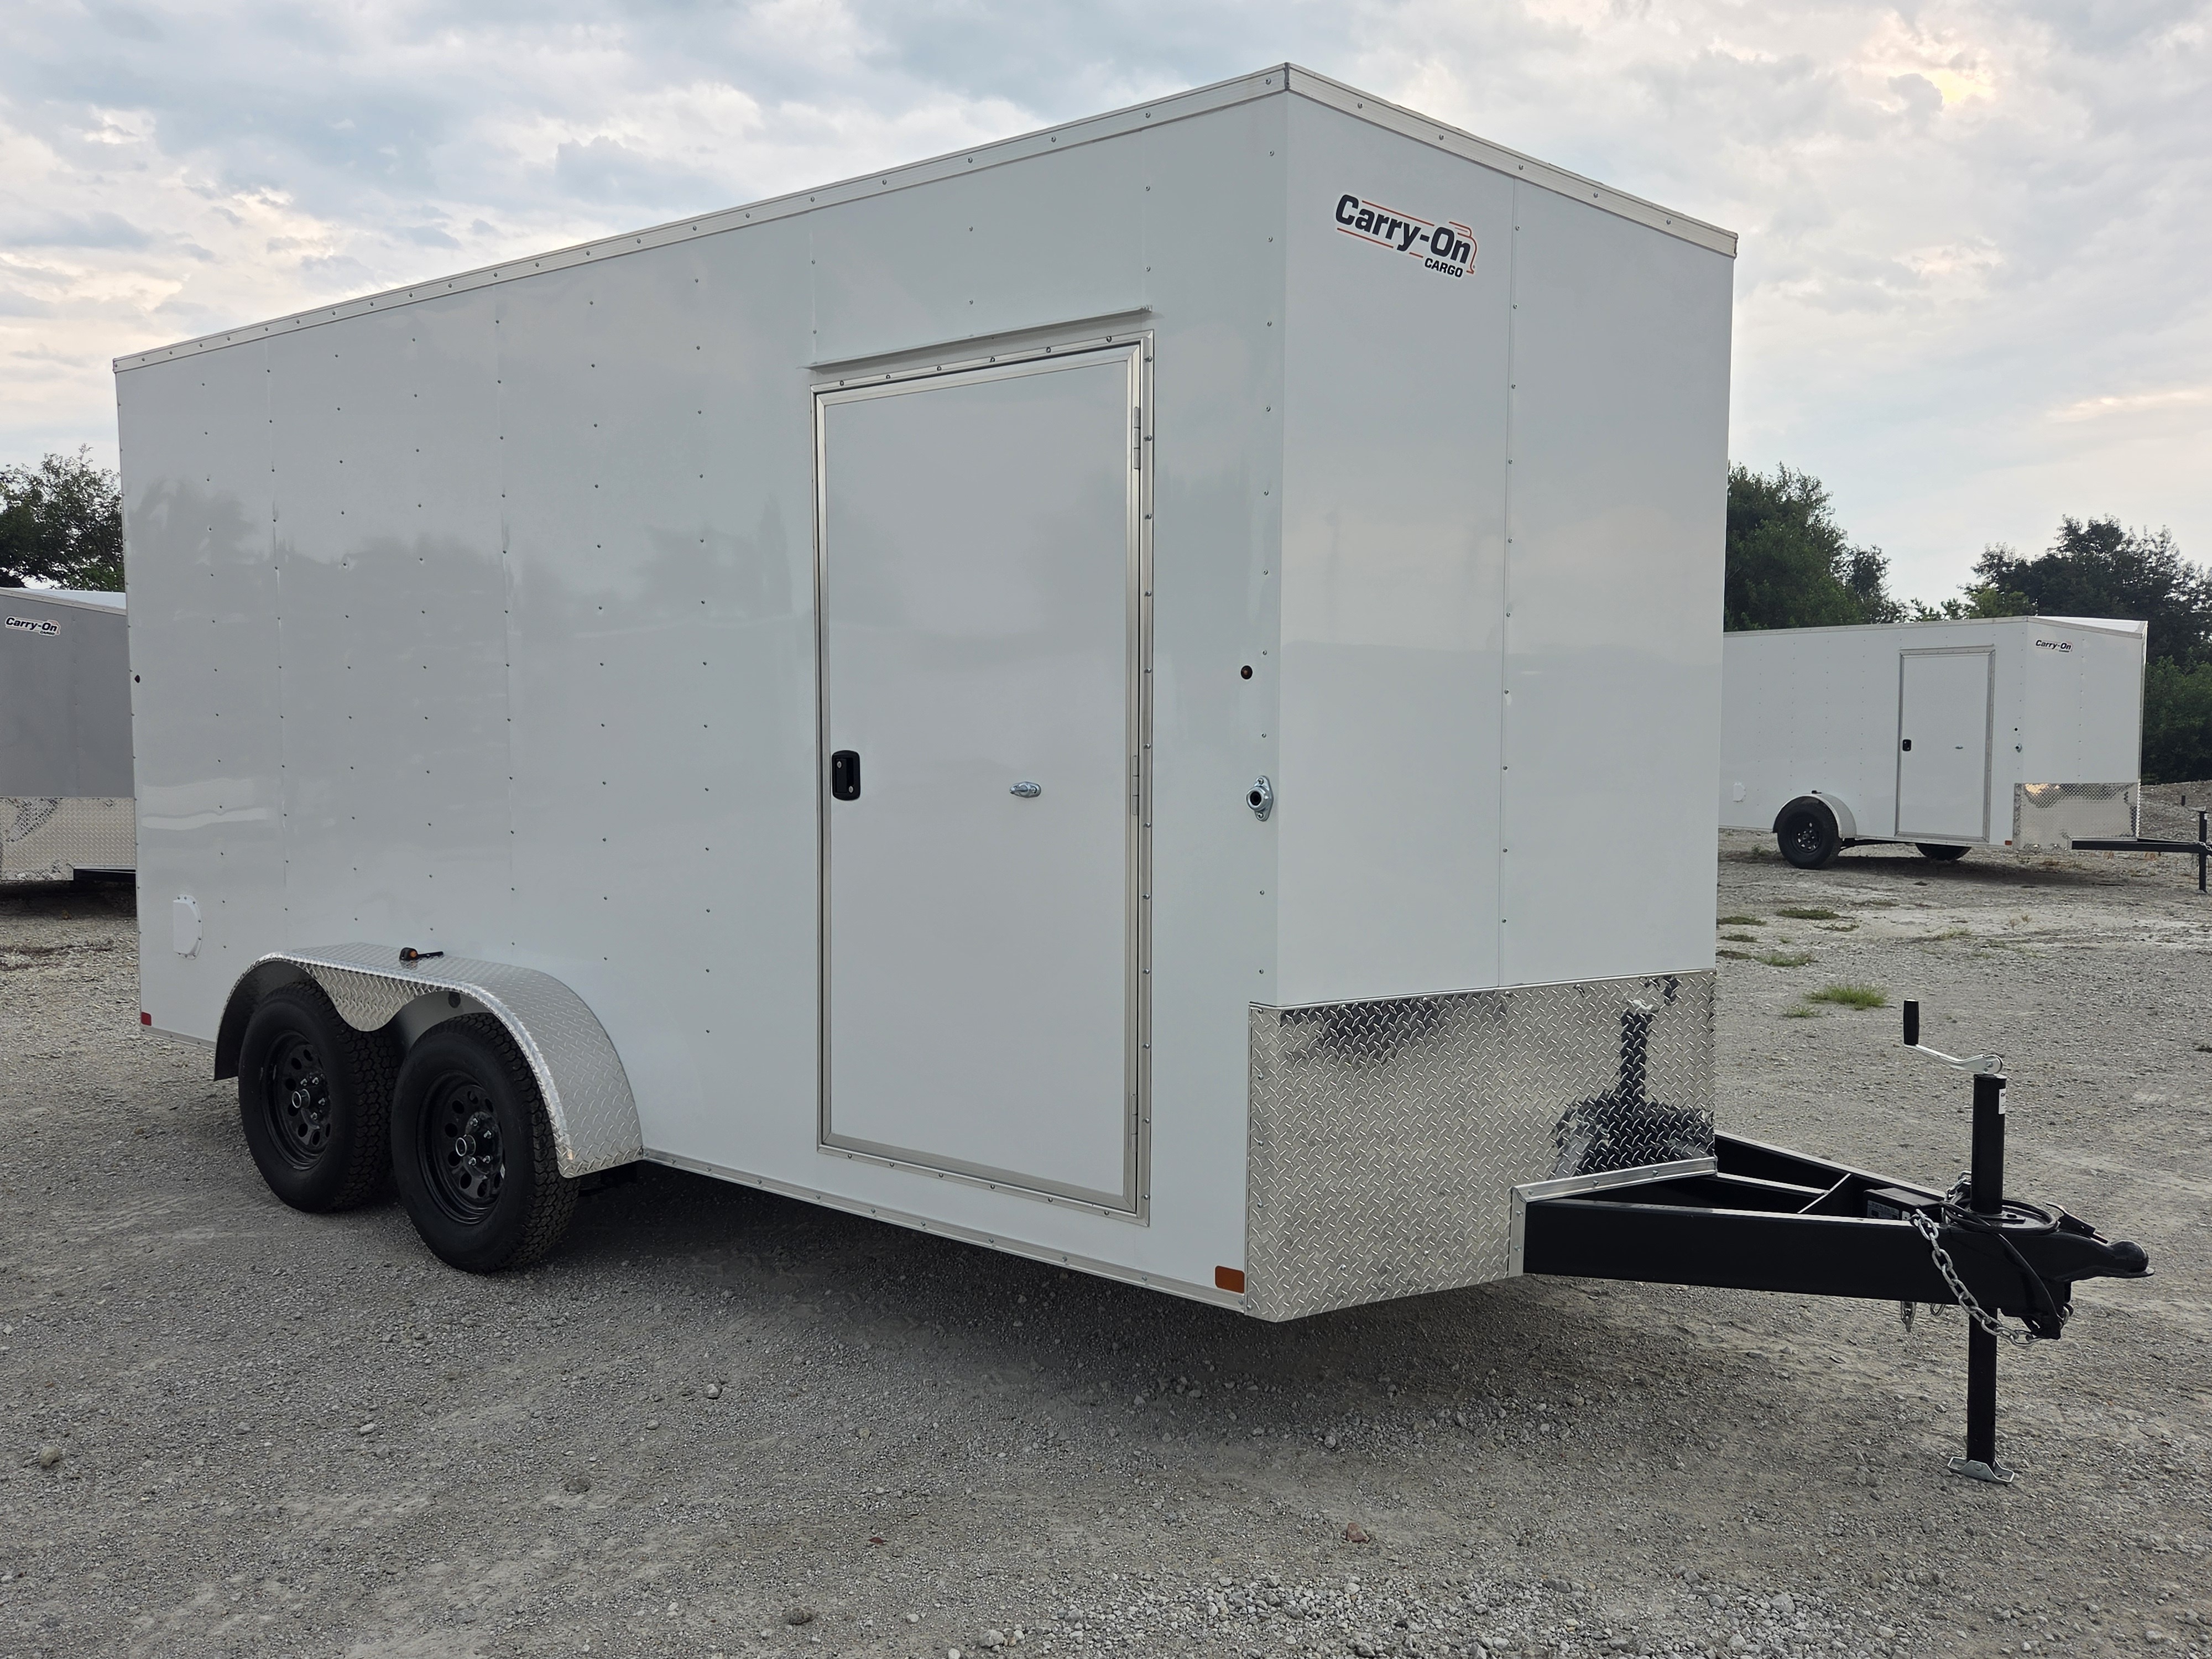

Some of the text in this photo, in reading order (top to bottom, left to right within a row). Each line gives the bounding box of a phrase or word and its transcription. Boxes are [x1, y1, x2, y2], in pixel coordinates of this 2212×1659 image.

[1335, 194, 1470, 264] Carry-On
[1425, 258, 1463, 278] CARGO
[6, 617, 58, 632] Carry-On
[2036, 640, 2072, 650] Carry-On
